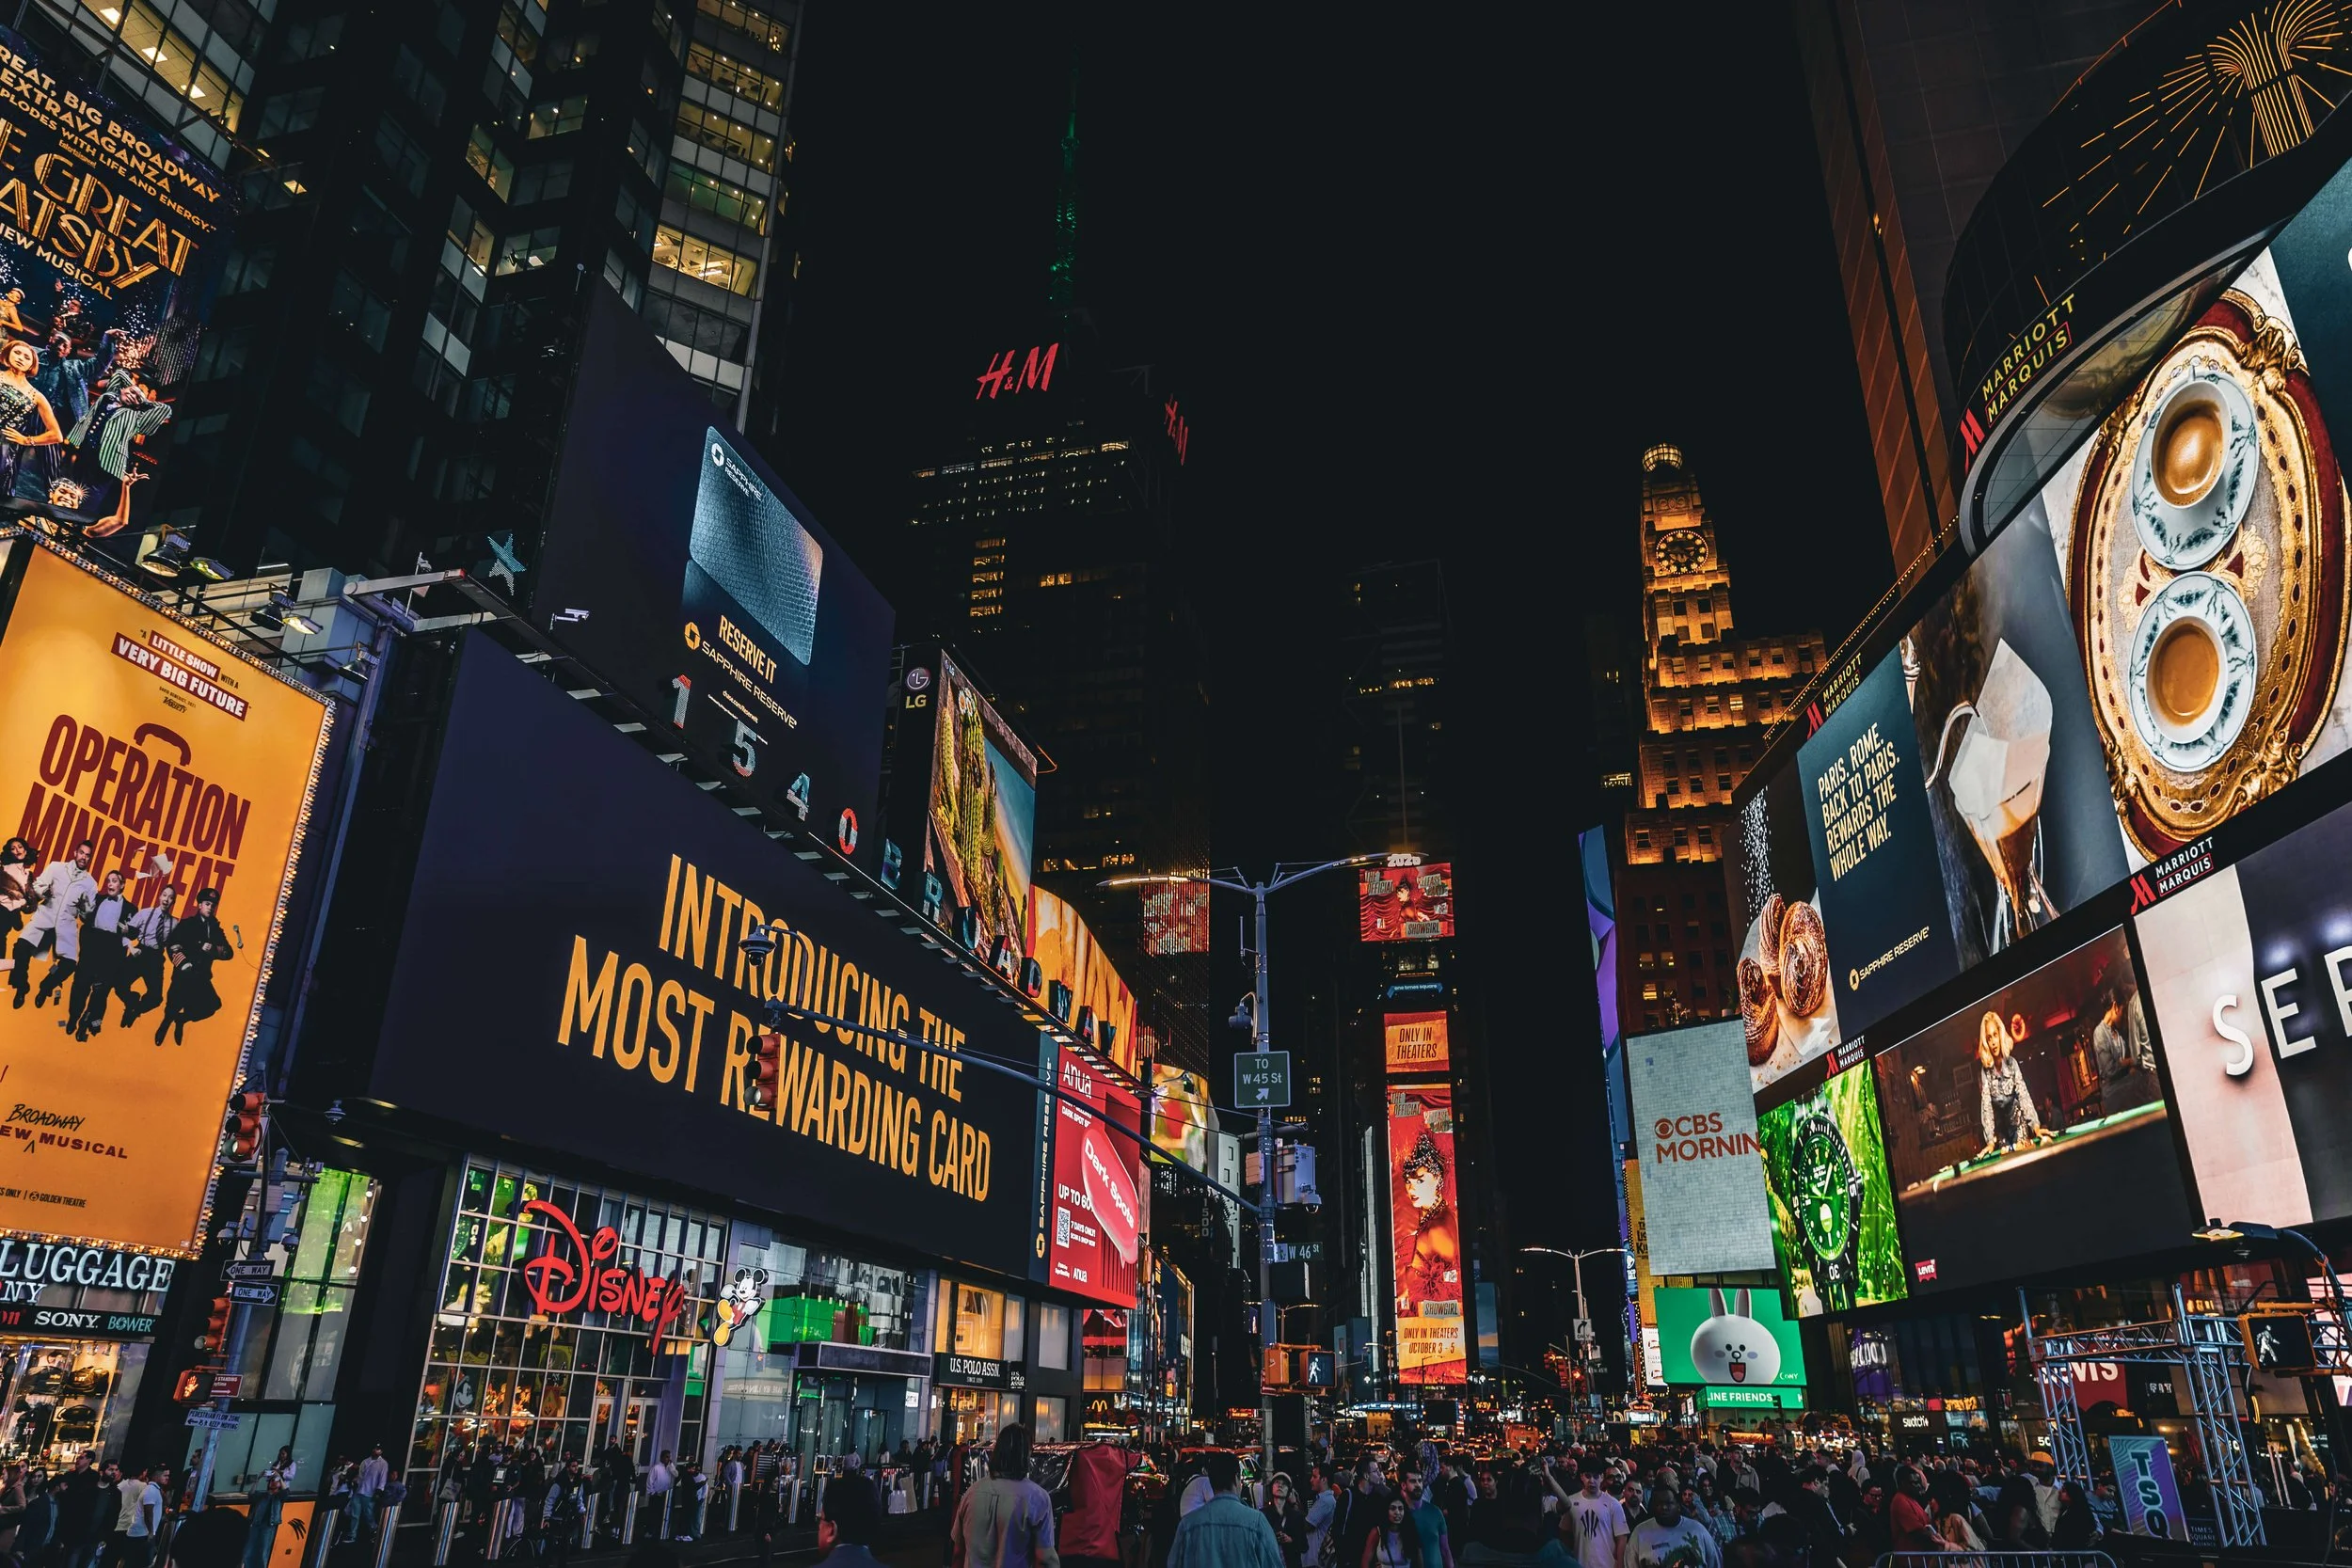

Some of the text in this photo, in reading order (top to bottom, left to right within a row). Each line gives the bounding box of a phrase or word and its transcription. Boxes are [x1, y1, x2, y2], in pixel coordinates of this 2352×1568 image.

[0, 68, 171, 194] EXTRAVAGANZA
[63, 90, 103, 125] BIG
[107, 120, 221, 204] BROADWAY
[62, 126, 97, 157] WITH
[99, 152, 128, 177] LIFE
[128, 175, 157, 197] AND
[34, 153, 200, 277] GREAT
[36, 245, 112, 300] MUSICAL
[1982, 293, 2075, 400] MARRIOTT
[976, 342, 1059, 400] H&M
[1988, 329, 2069, 423] MARQUIS
[725, 457, 762, 501] SAPPHIRE
[119, 637, 161, 671] VERY
[160, 660, 188, 688] BIG
[151, 634, 185, 661] LITTLE
[185, 654, 218, 678] SHOW
[220, 673, 234, 686] WITH
[719, 614, 777, 684] RESERVE IT
[702, 641, 754, 692] SAPPHIRE
[754, 685, 797, 729] RESERVE
[1822, 653, 1864, 700] MARRIOTT
[906, 694, 927, 709] LG
[1825, 673, 1861, 720] MARQUIS
[1817, 721, 1884, 802] PARIS. ROME.
[40, 714, 251, 860] OPERATION
[1821, 741, 1900, 830] BACK TO PARIS.
[1826, 777, 1897, 854] REWARDS THE
[1830, 813, 1892, 881] WHOLE WAY.
[2154, 837, 2215, 879] MARRIOTT
[2158, 856, 2212, 895] MARQUIS
[1407, 922, 1439, 935] SHOWGIRL
[1858, 927, 1930, 983] SAPPHIRE RESERVE
[659, 853, 966, 1102] INTRODUCING THE
[1397, 1043, 1438, 1059] THEATERS
[1400, 1027, 1432, 1043] ONLY IN
[1836, 1035, 1866, 1058] MARRIOTT
[557, 935, 715, 1094] MOST
[928, 1106, 991, 1204] CARD
[1255, 1059, 1268, 1069] TO
[1837, 1046, 1866, 1069] MARQUIS
[1063, 1061, 1092, 1100] Anua
[1243, 1072, 1281, 1084] W 45 St
[5, 1103, 86, 1132] BROADWAY
[1672, 1112, 1724, 1136] CBS
[39, 1132, 128, 1159] MUSICAL
[1656, 1131, 1761, 1164] MORNIN
[5, 1188, 22, 1198] ONLY
[40, 1193, 63, 1205] GOLDEN
[62, 1196, 87, 1209] THEATRE
[1039, 1141, 1048, 1228] SAPPHIRE
[1058, 1183, 1093, 1212] UP TO 60
[1084, 1137, 1135, 1230] Dark Spots
[0, 1239, 177, 1292] LUGGAGE
[230, 1266, 267, 1275] ONE WAY
[1289, 1243, 1319, 1259] W 46 St
[0, 1280, 47, 1304] NY
[237, 1288, 271, 1298] ONE WAY
[524, 1200, 685, 1357] Disney
[107, 1316, 153, 1333] BOWER
[1424, 1303, 1458, 1315] SHOWGIRL
[1404, 1327, 1459, 1339] ONLY IN THEATERS
[1409, 1343, 1436, 1354] OCTOBER
[1438, 1343, 1443, 1354] 3
[1451, 1342, 1454, 1354] 5
[950, 1358, 1000, 1377] U.S. POLO ASSN.
[2041, 1354, 2119, 1385] LEVIS
[189, 1411, 215, 1419] PEDESTRIAN
[229, 1414, 241, 1422] ZONE
[1729, 1392, 1772, 1402] FRIENDS
[1902, 1416, 1926, 1428] swatch
